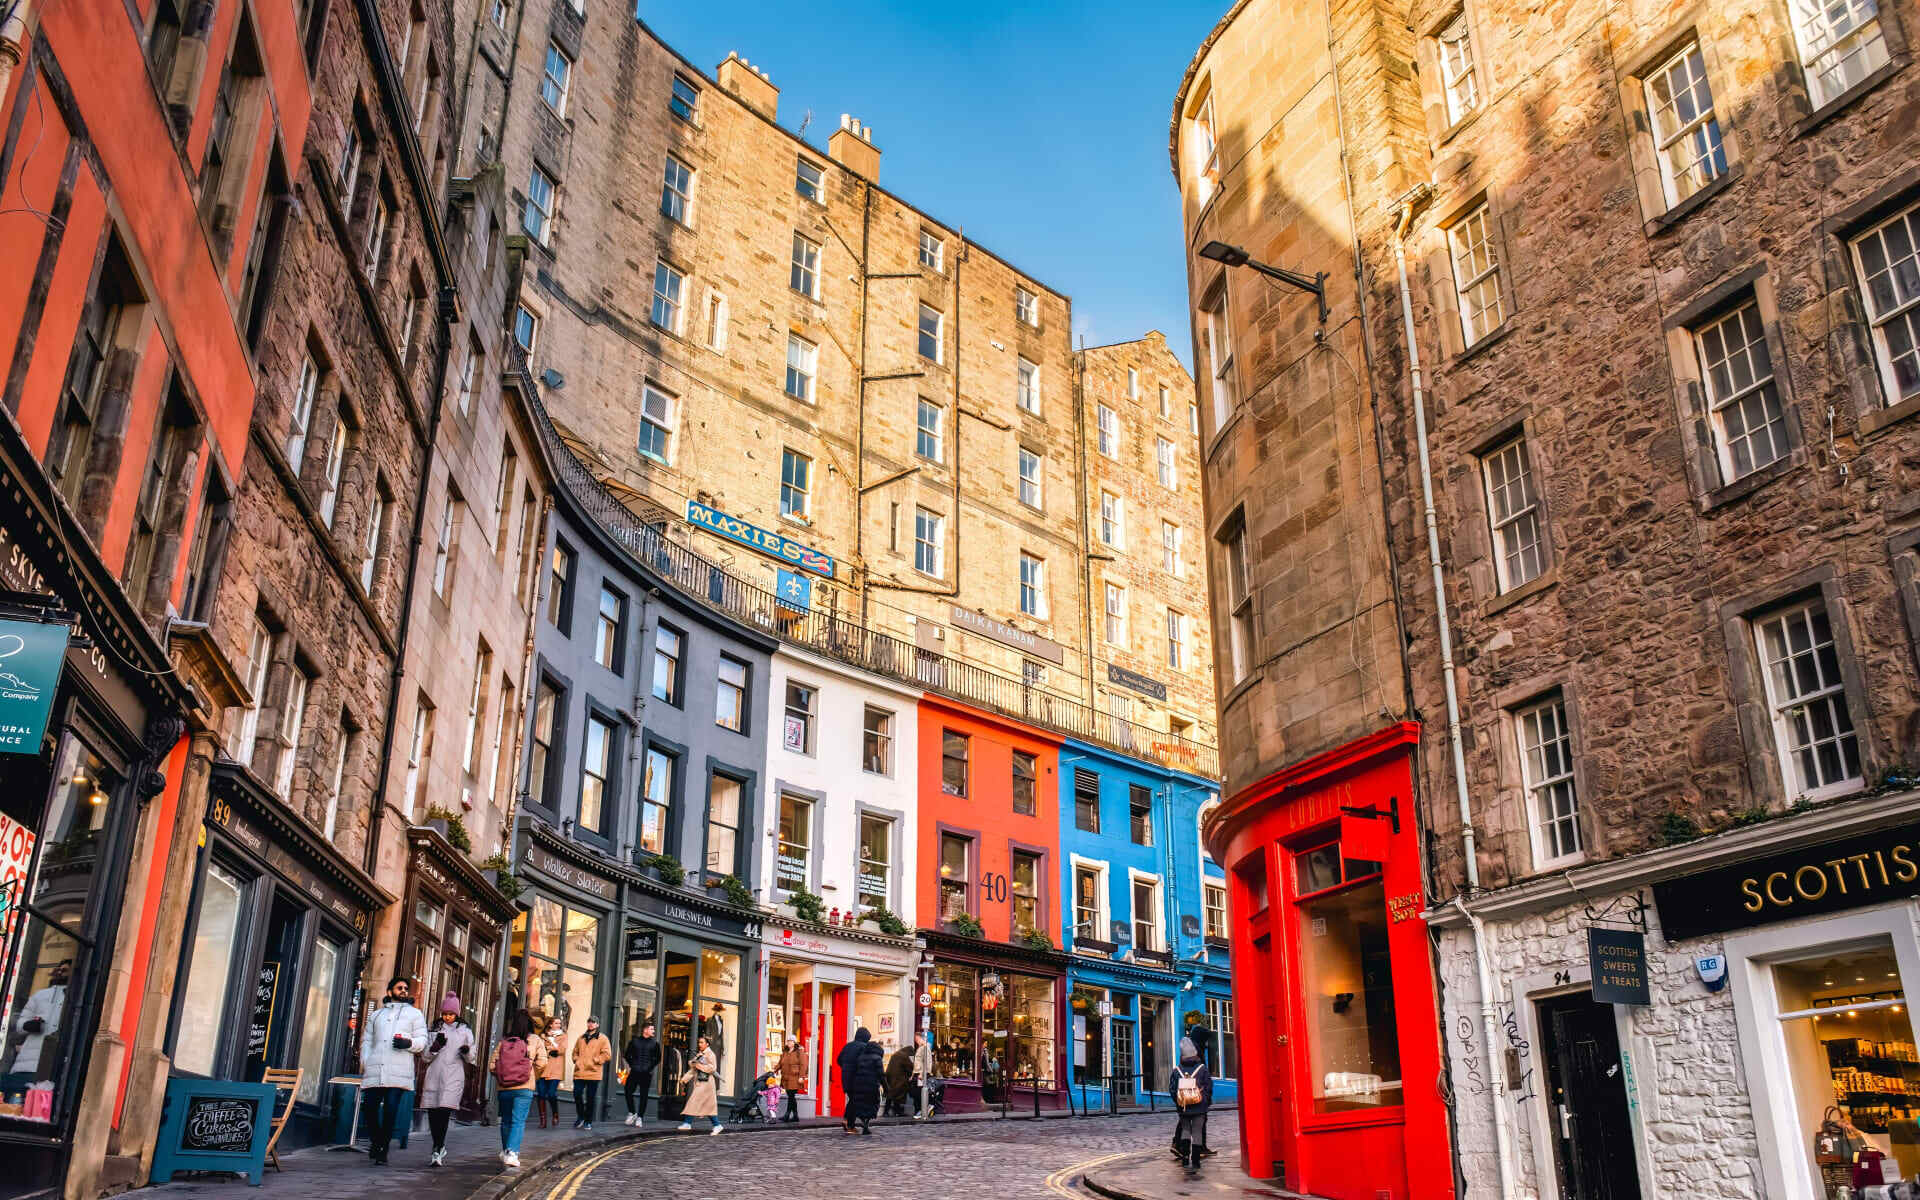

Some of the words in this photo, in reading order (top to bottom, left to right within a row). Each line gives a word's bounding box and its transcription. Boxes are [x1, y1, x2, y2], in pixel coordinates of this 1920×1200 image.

[690, 505, 801, 560] MAXIES
[11, 543, 44, 592] SKYE
[91, 646, 107, 678] CO.
[2, 691, 39, 701] Company
[214, 798, 231, 826] 89
[544, 856, 572, 881] Walker
[577, 871, 607, 894] Slater
[1741, 842, 1920, 912] SCOTTIS
[980, 871, 1007, 904] 40
[1388, 892, 1421, 911] WEST
[354, 910, 366, 930] 89
[665, 904, 712, 928] LADIESWEAR
[1393, 906, 1417, 923] BOW
[1597, 945, 1639, 957] SCOTTISH
[1554, 969, 1571, 985] 94
[1603, 960, 1636, 973] SWEETS
[1602, 974, 1608, 985] &
[1610, 975, 1641, 988] TREATS
